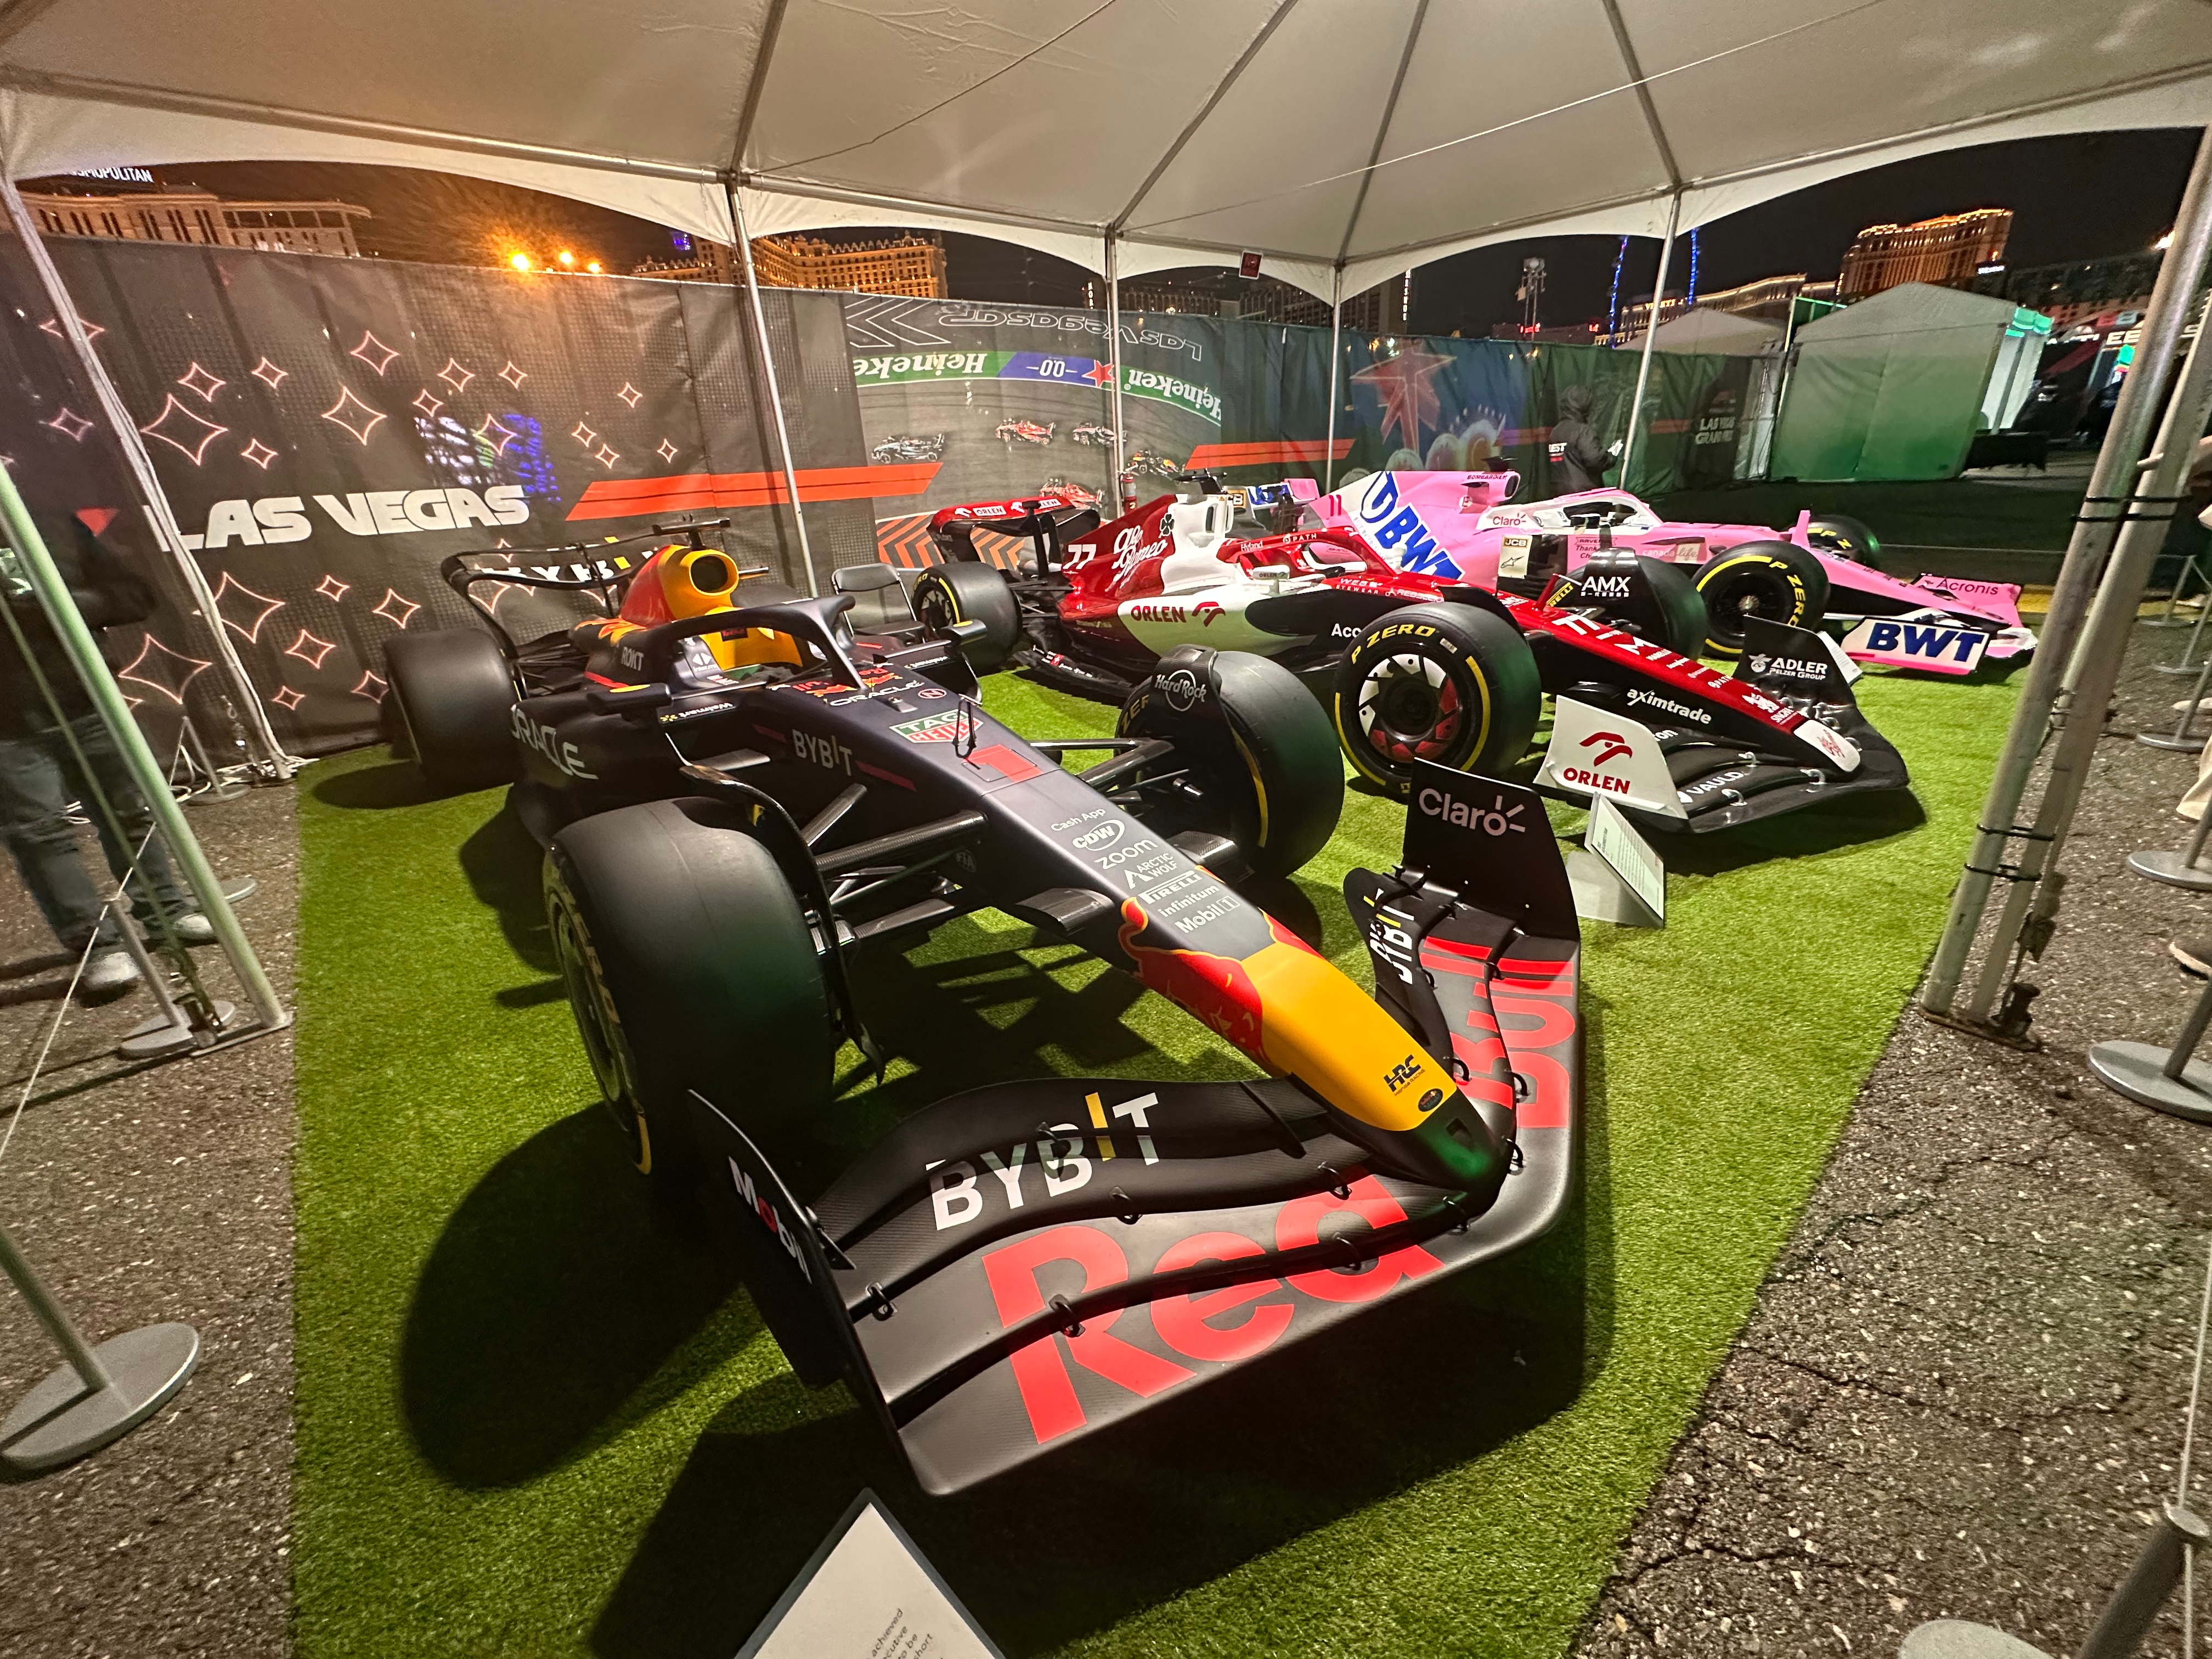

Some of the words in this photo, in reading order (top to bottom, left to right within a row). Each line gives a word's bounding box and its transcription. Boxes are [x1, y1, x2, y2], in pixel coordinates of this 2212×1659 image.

[143, 496, 312, 552] LAS
[313, 485, 530, 535] VEGAS
[977, 507, 1004, 516] ORLEN
[1063, 544, 1097, 569] 77
[1240, 540, 1263, 552] Hyland
[1581, 576, 1632, 592] AMX
[1937, 578, 1999, 595] Acronis
[1131, 605, 1187, 623] ORLEN
[1366, 624, 1436, 648] ZERO
[1866, 622, 1985, 663] BWT
[621, 646, 645, 672] ROKT
[1771, 657, 1828, 674] ADLER
[830, 680, 925, 707] ORACLE
[1627, 689, 1712, 724] aximtrade
[899, 712, 964, 732] TAG
[792, 729, 853, 776] BYBIT
[1563, 767, 1631, 794] ORLEN
[1686, 771, 1745, 795] VAULD
[1051, 817, 1082, 831] Cash
[1080, 809, 1106, 821] App
[1073, 825, 1115, 849] CDW
[1093, 839, 1159, 870] zoom
[1136, 852, 1174, 873] ARCTIC
[1148, 860, 1178, 878] WOLF
[1138, 870, 1203, 905] PIRELLI
[1157, 885, 1220, 917] infinitum
[1175, 902, 1225, 934] Mobil
[925, 1091, 1160, 1231] BYBIT
